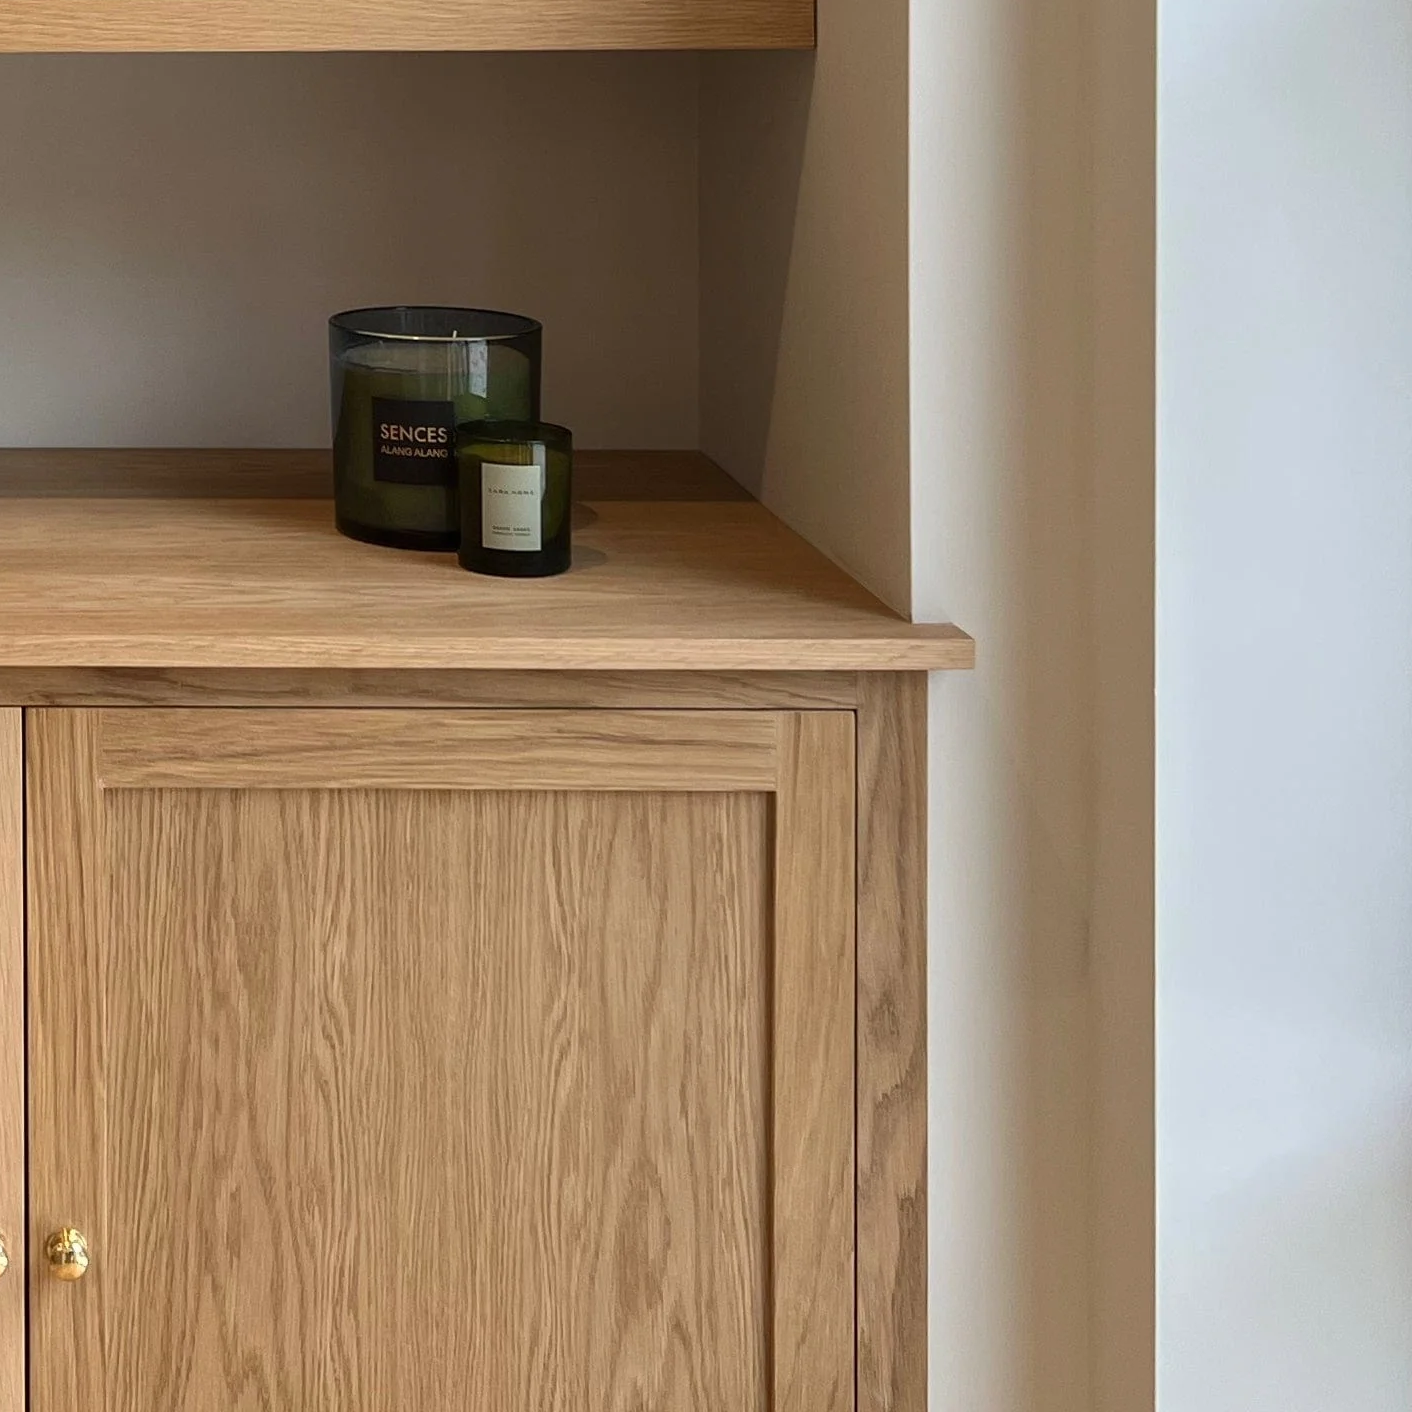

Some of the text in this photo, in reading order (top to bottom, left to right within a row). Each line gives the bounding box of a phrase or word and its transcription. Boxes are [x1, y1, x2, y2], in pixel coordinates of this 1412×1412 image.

[380, 423, 448, 443] SENCES
[380, 445, 448, 458] ALANG ALANG
